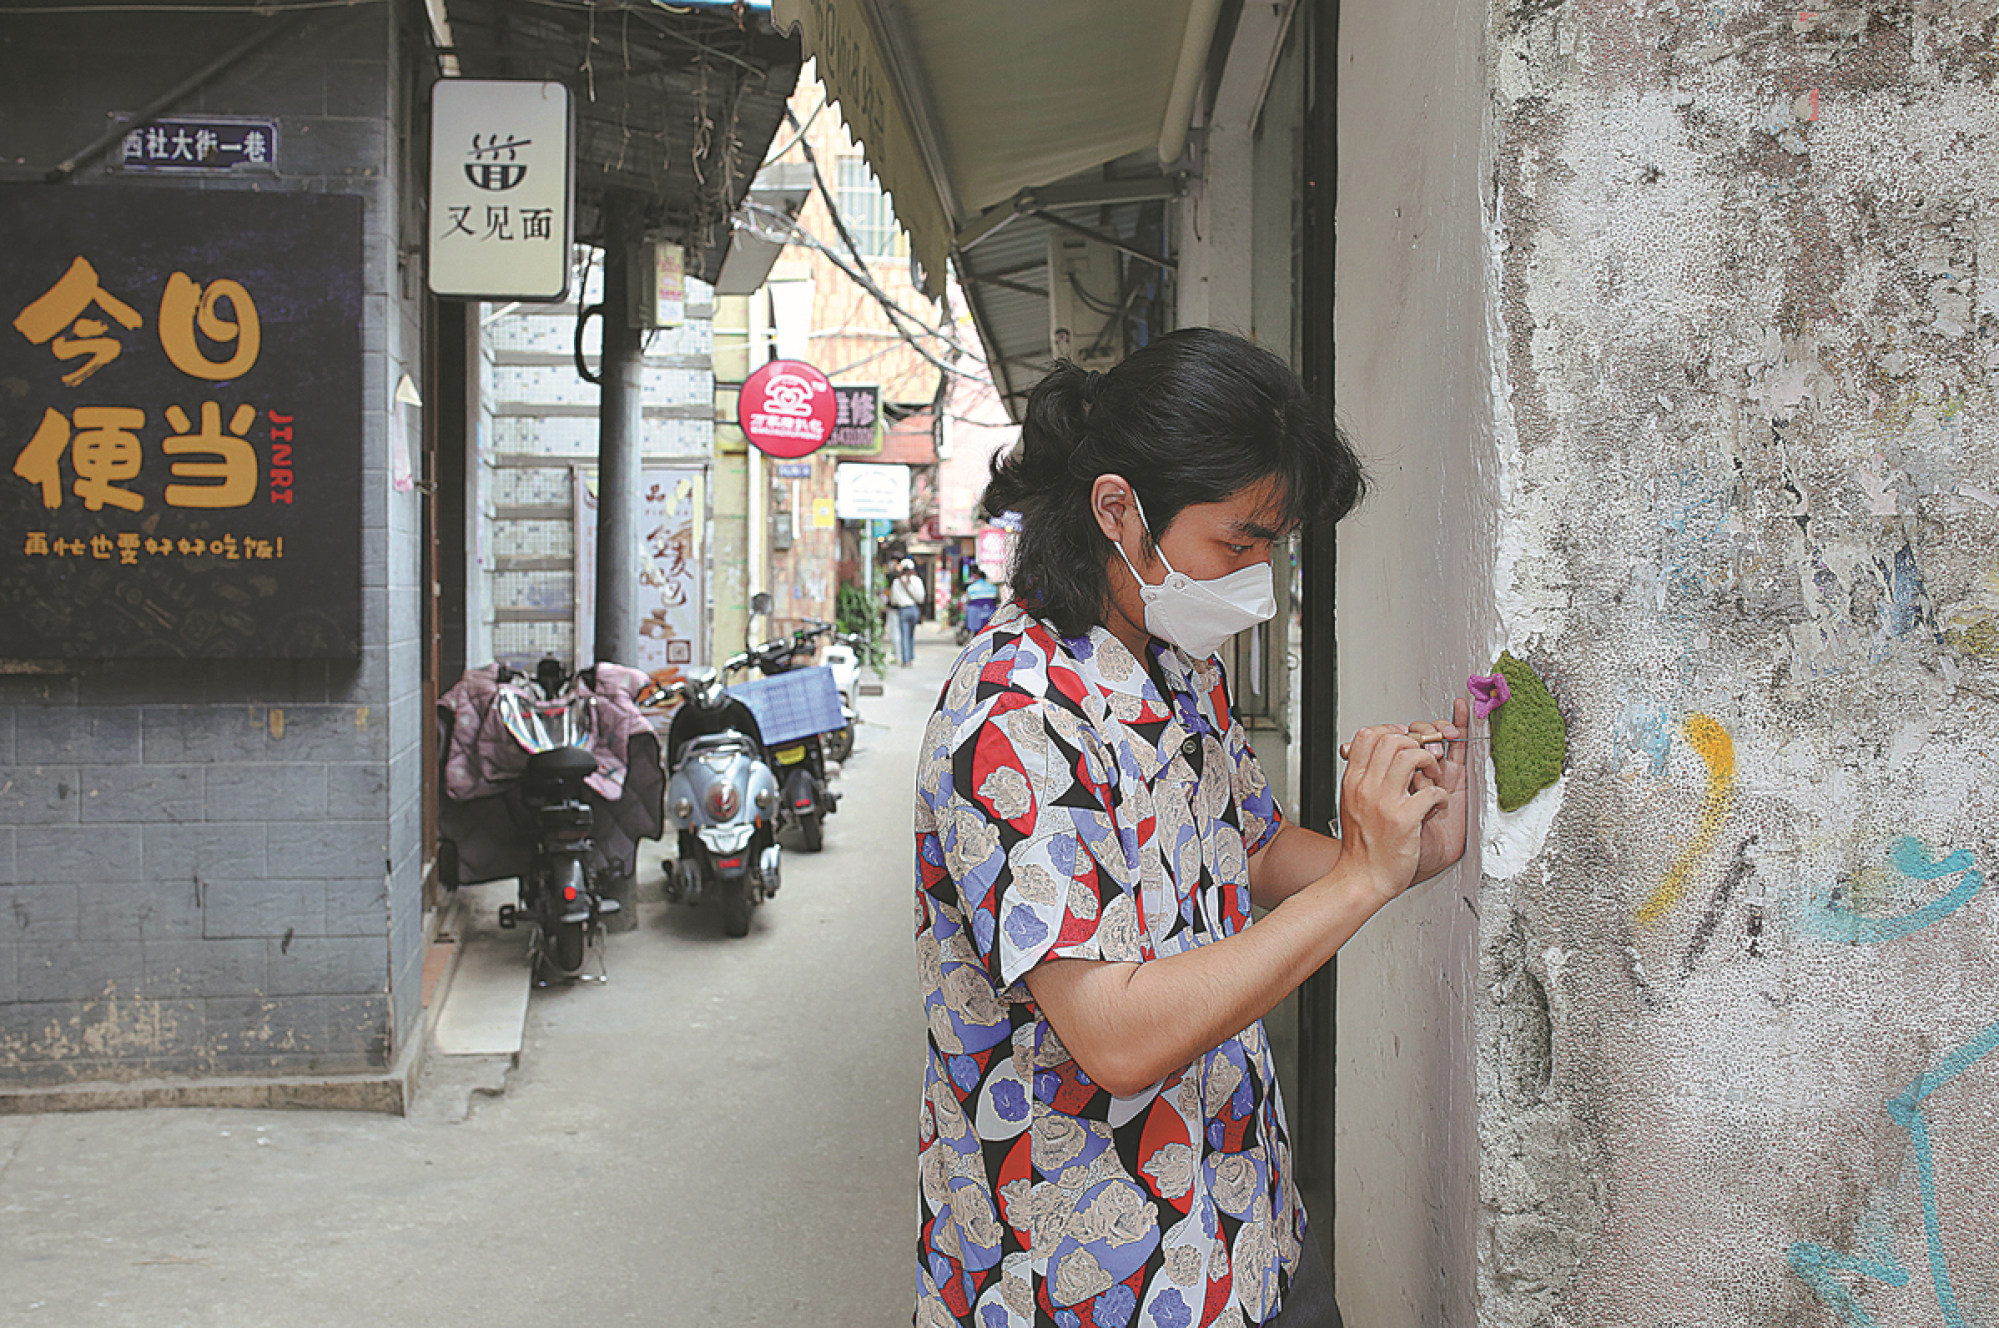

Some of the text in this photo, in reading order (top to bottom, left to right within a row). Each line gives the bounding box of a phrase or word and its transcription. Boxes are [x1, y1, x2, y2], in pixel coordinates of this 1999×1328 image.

[123, 127, 267, 163] 西社大街一巷
[441, 204, 553, 241] 又见面
[13, 256, 261, 387] 今日
[13, 401, 257, 512] 便当
[268, 410, 293, 504] JINRI
[25, 531, 283, 565] 再忙也要好好吃饭!
